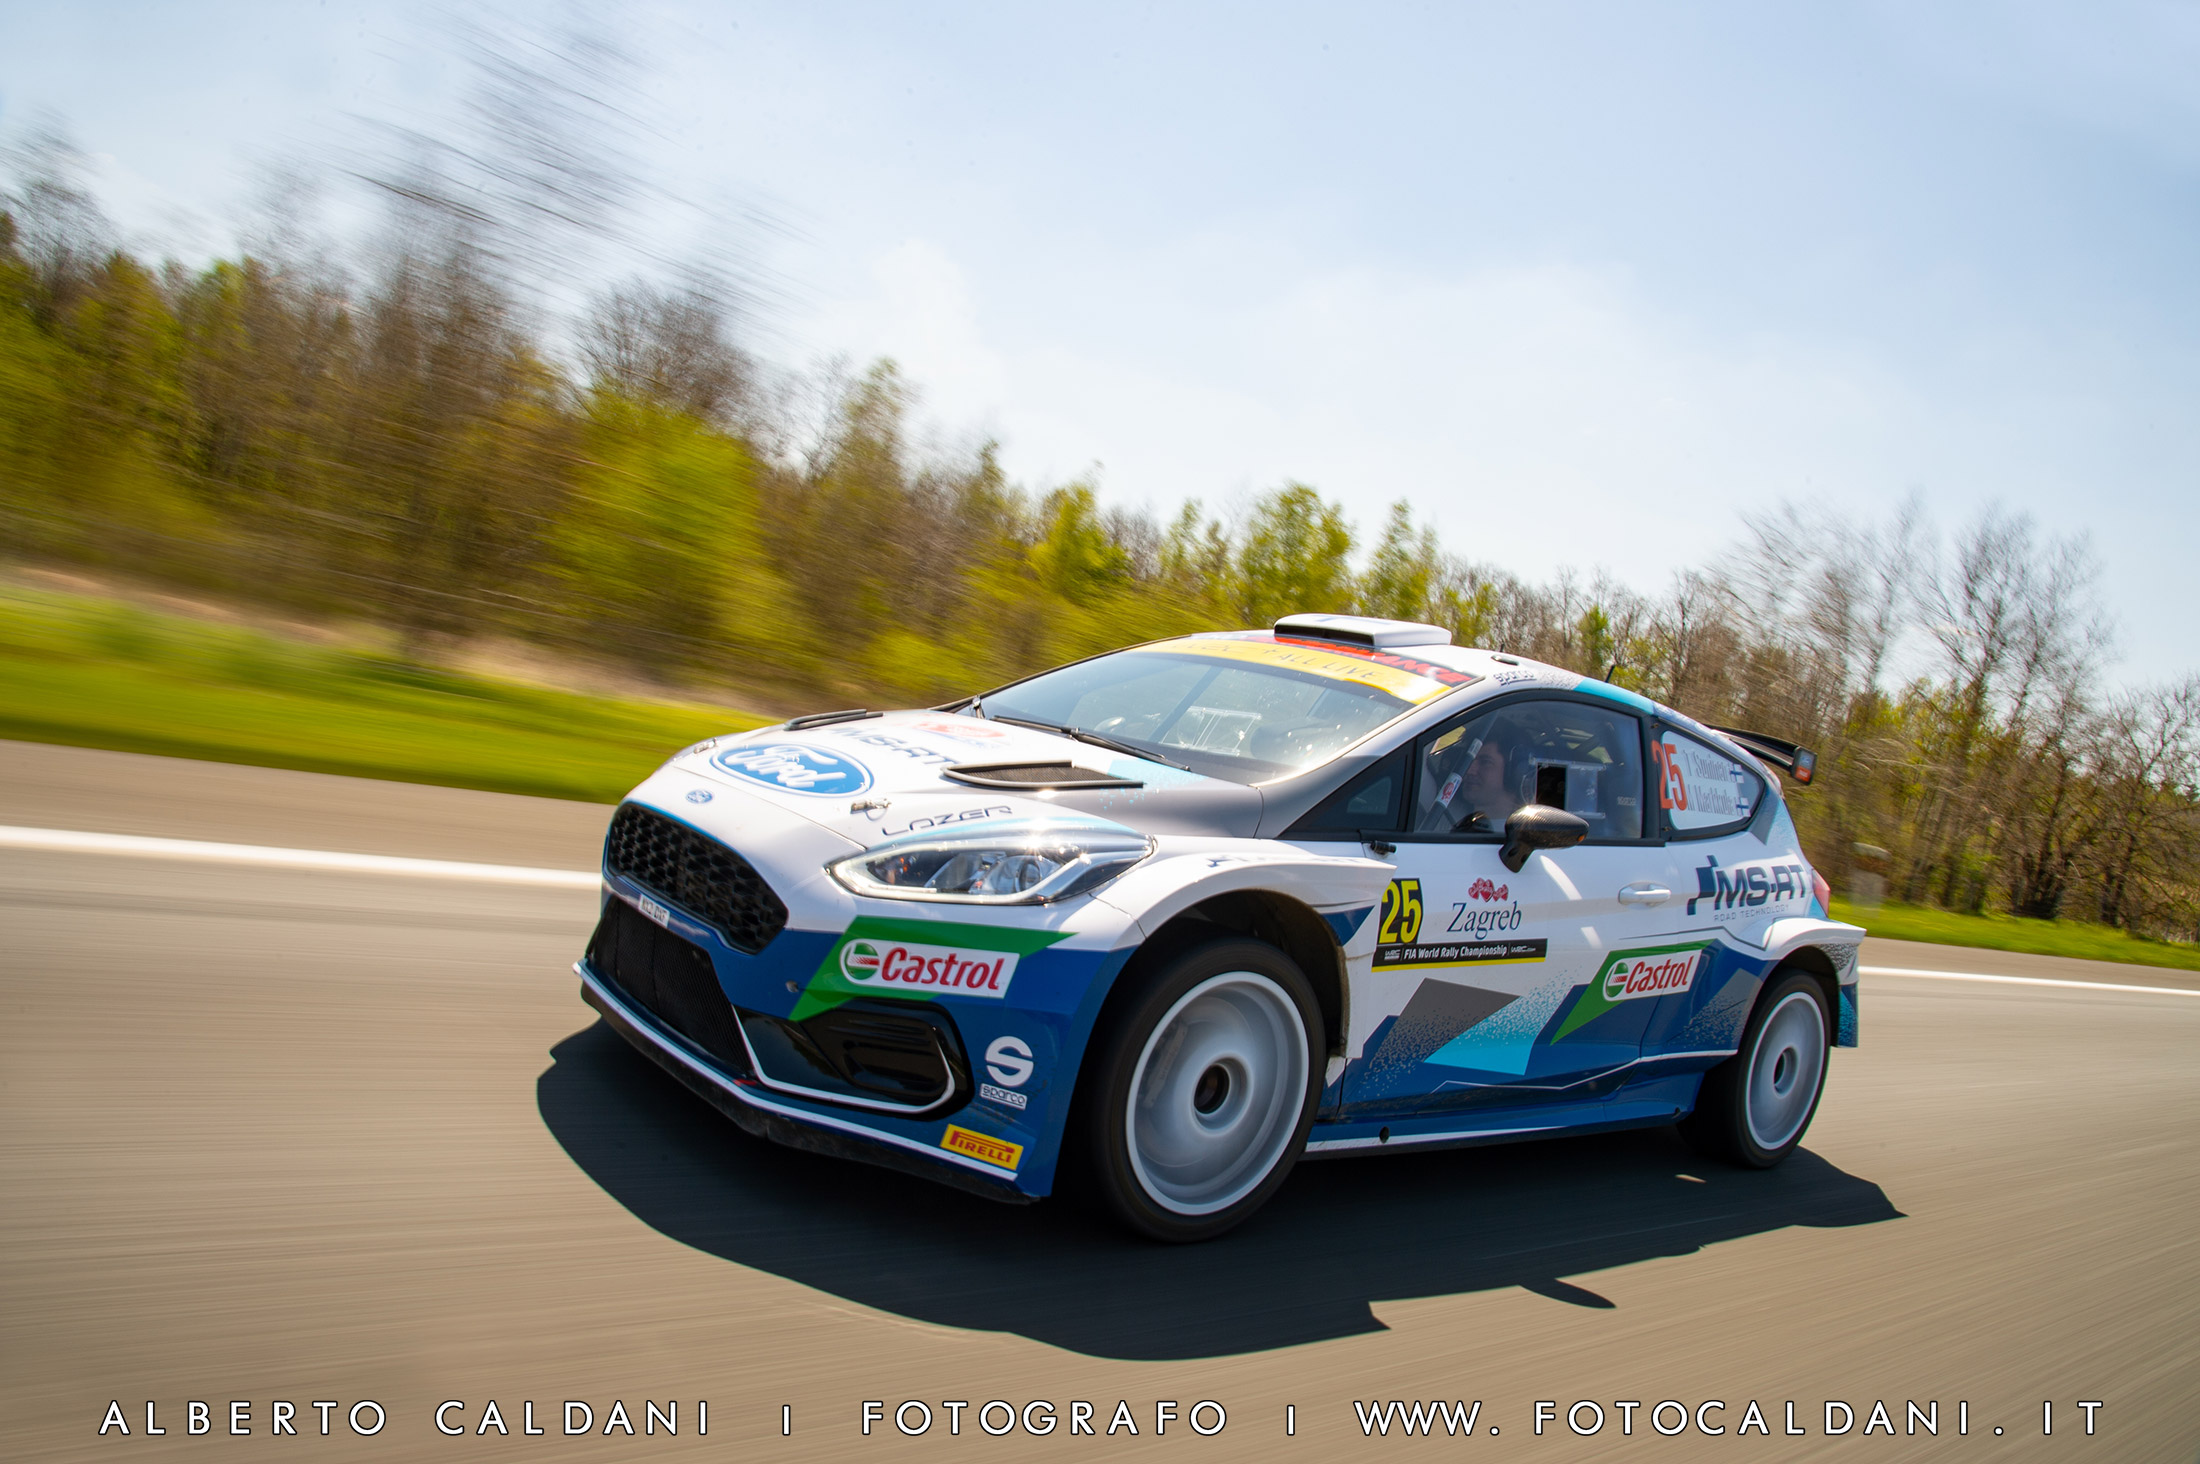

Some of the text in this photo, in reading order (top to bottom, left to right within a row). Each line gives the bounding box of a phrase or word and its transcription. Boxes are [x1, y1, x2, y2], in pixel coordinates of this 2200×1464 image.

[722, 744, 850, 789] Ford
[1652, 739, 1688, 811] 25
[881, 805, 1013, 836] LAZER
[1378, 880, 1422, 944] 25
[1446, 900, 1522, 940] Zagreb
[1713, 903, 1790, 922] ROAD TECHNOLOGY
[881, 947, 1005, 990] Castrol
[1403, 948, 1417, 960] FIA
[1418, 947, 1440, 959] World
[1440, 946, 1460, 960] Rally
[1460, 944, 1508, 958] Championship
[1625, 955, 1695, 994] Castrol
[982, 1085, 1026, 1106] sparco
[949, 1130, 1015, 1163] PIRELLI
